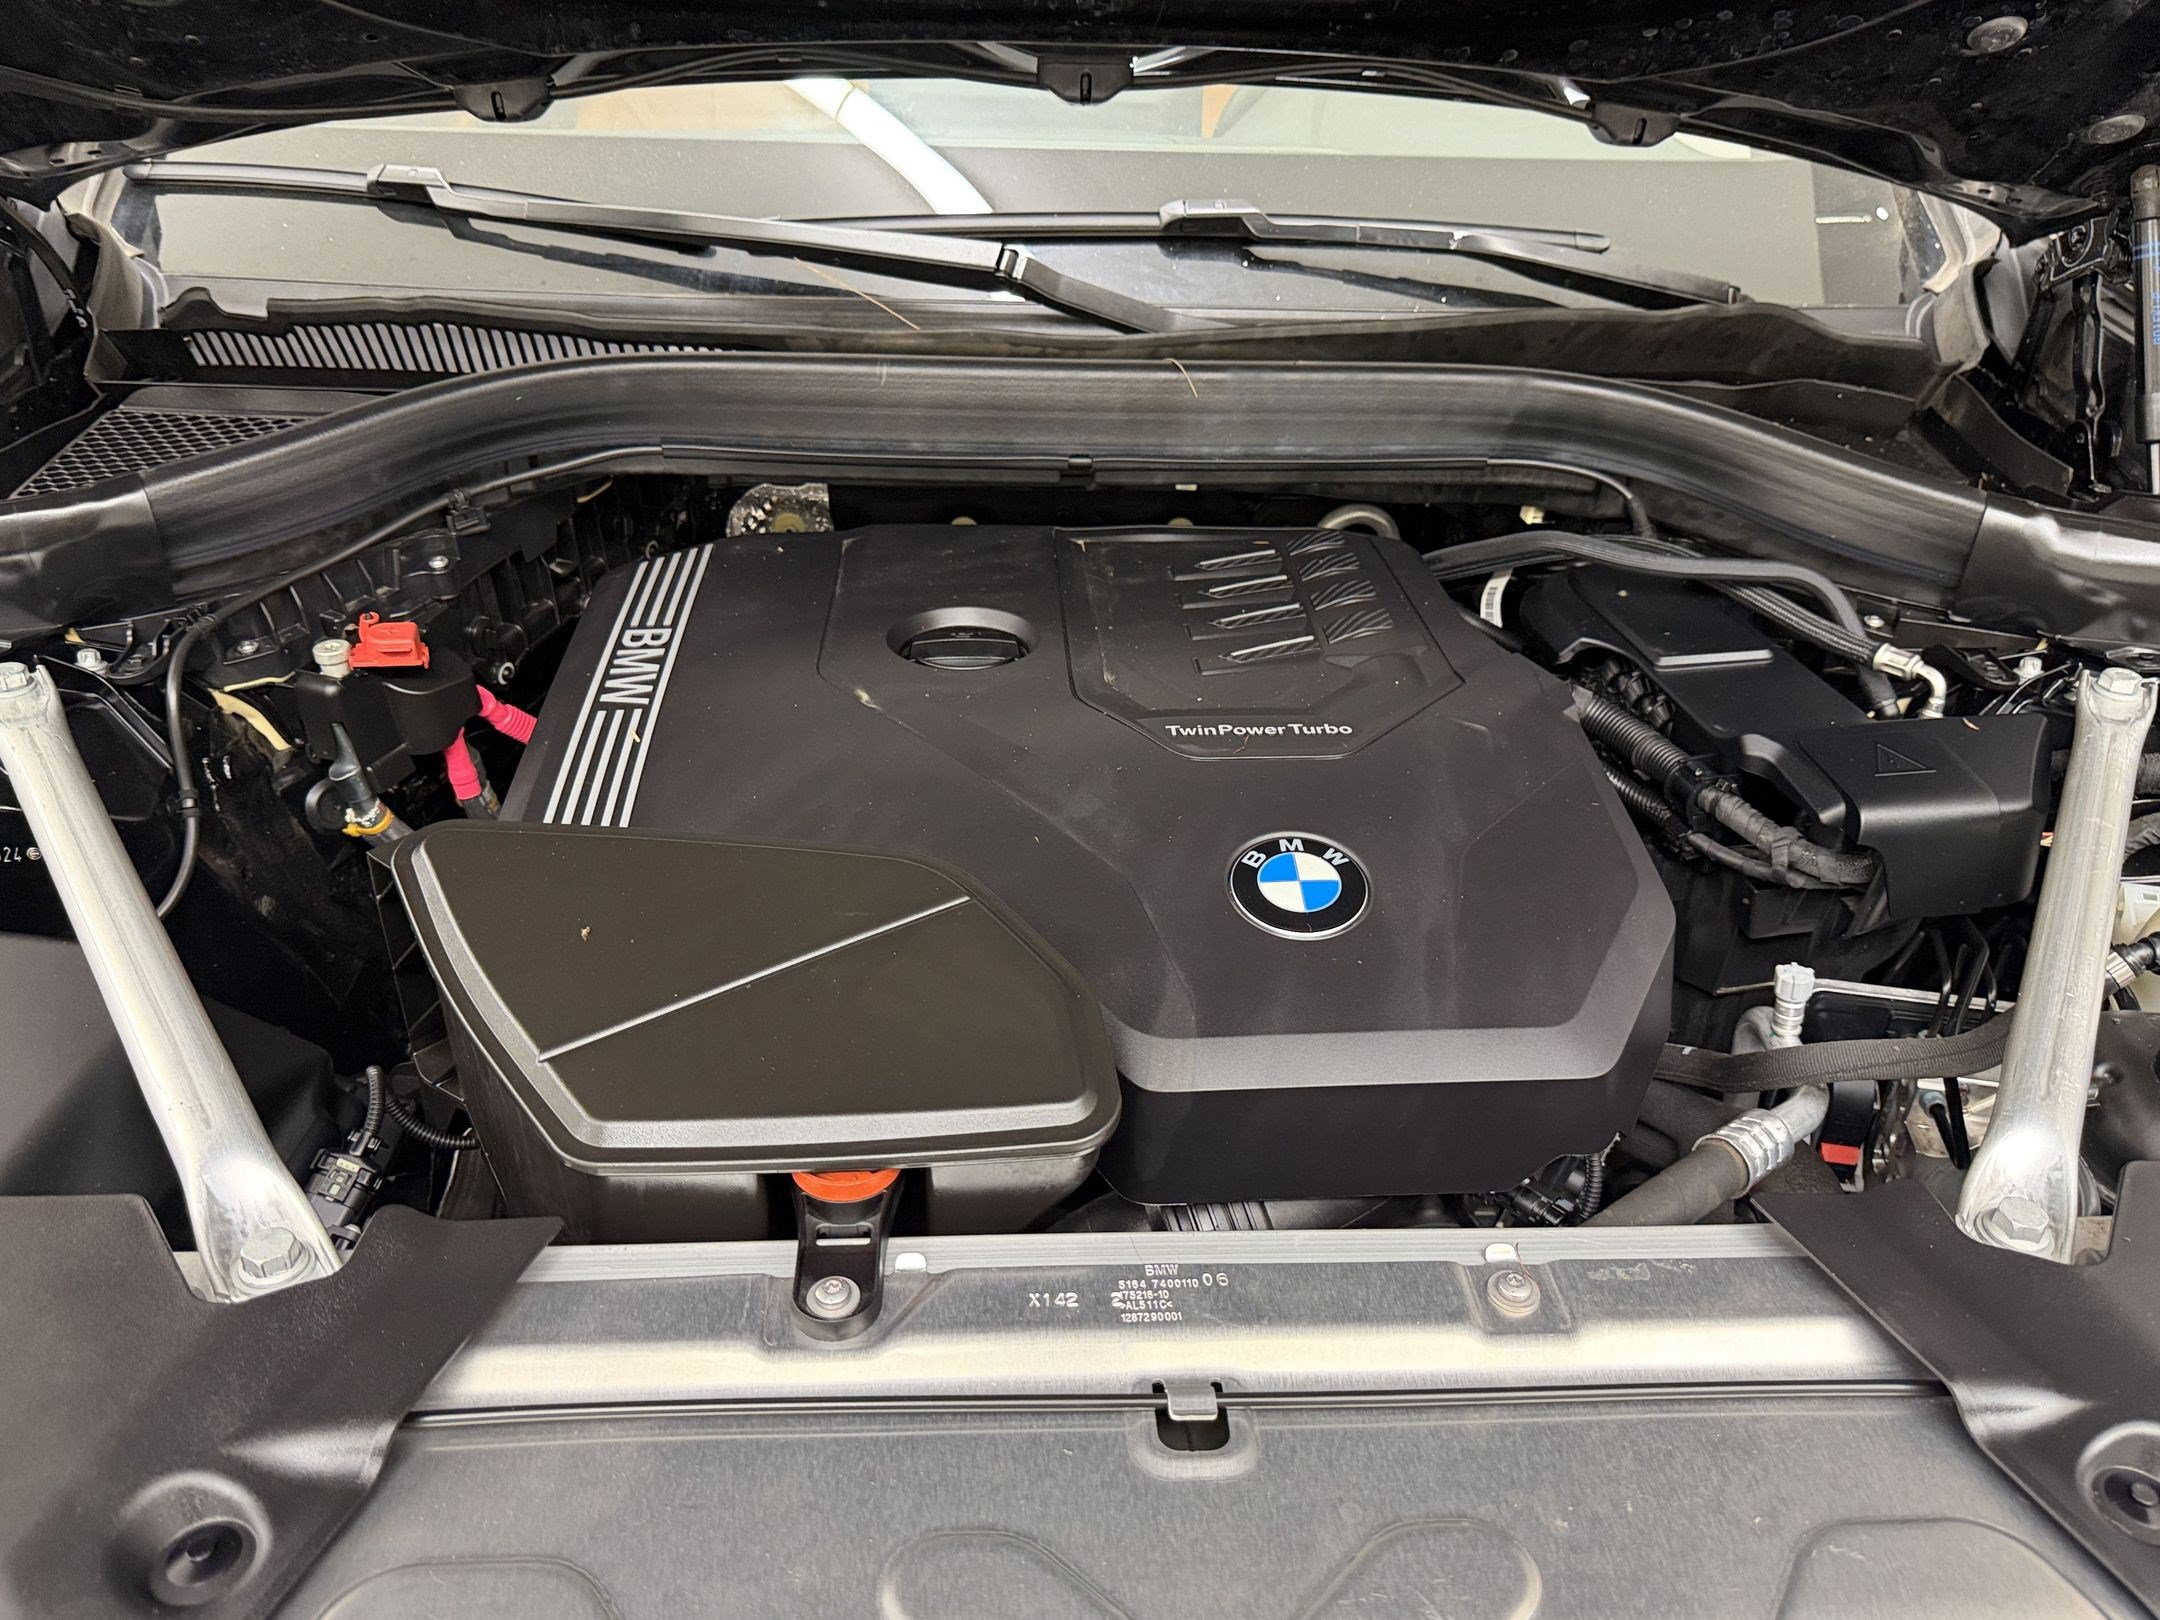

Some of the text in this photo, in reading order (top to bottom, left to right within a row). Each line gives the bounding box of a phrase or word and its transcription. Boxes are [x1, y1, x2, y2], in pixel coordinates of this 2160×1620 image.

[600, 628, 673, 705] BMW
[1165, 723, 1353, 736] TwinPower Turbo
[0, 846, 22, 863] 24
[1241, 839, 1349, 869] BMW
[1145, 1264, 1179, 1277] BMW
[1028, 1292, 1079, 1308] X142
